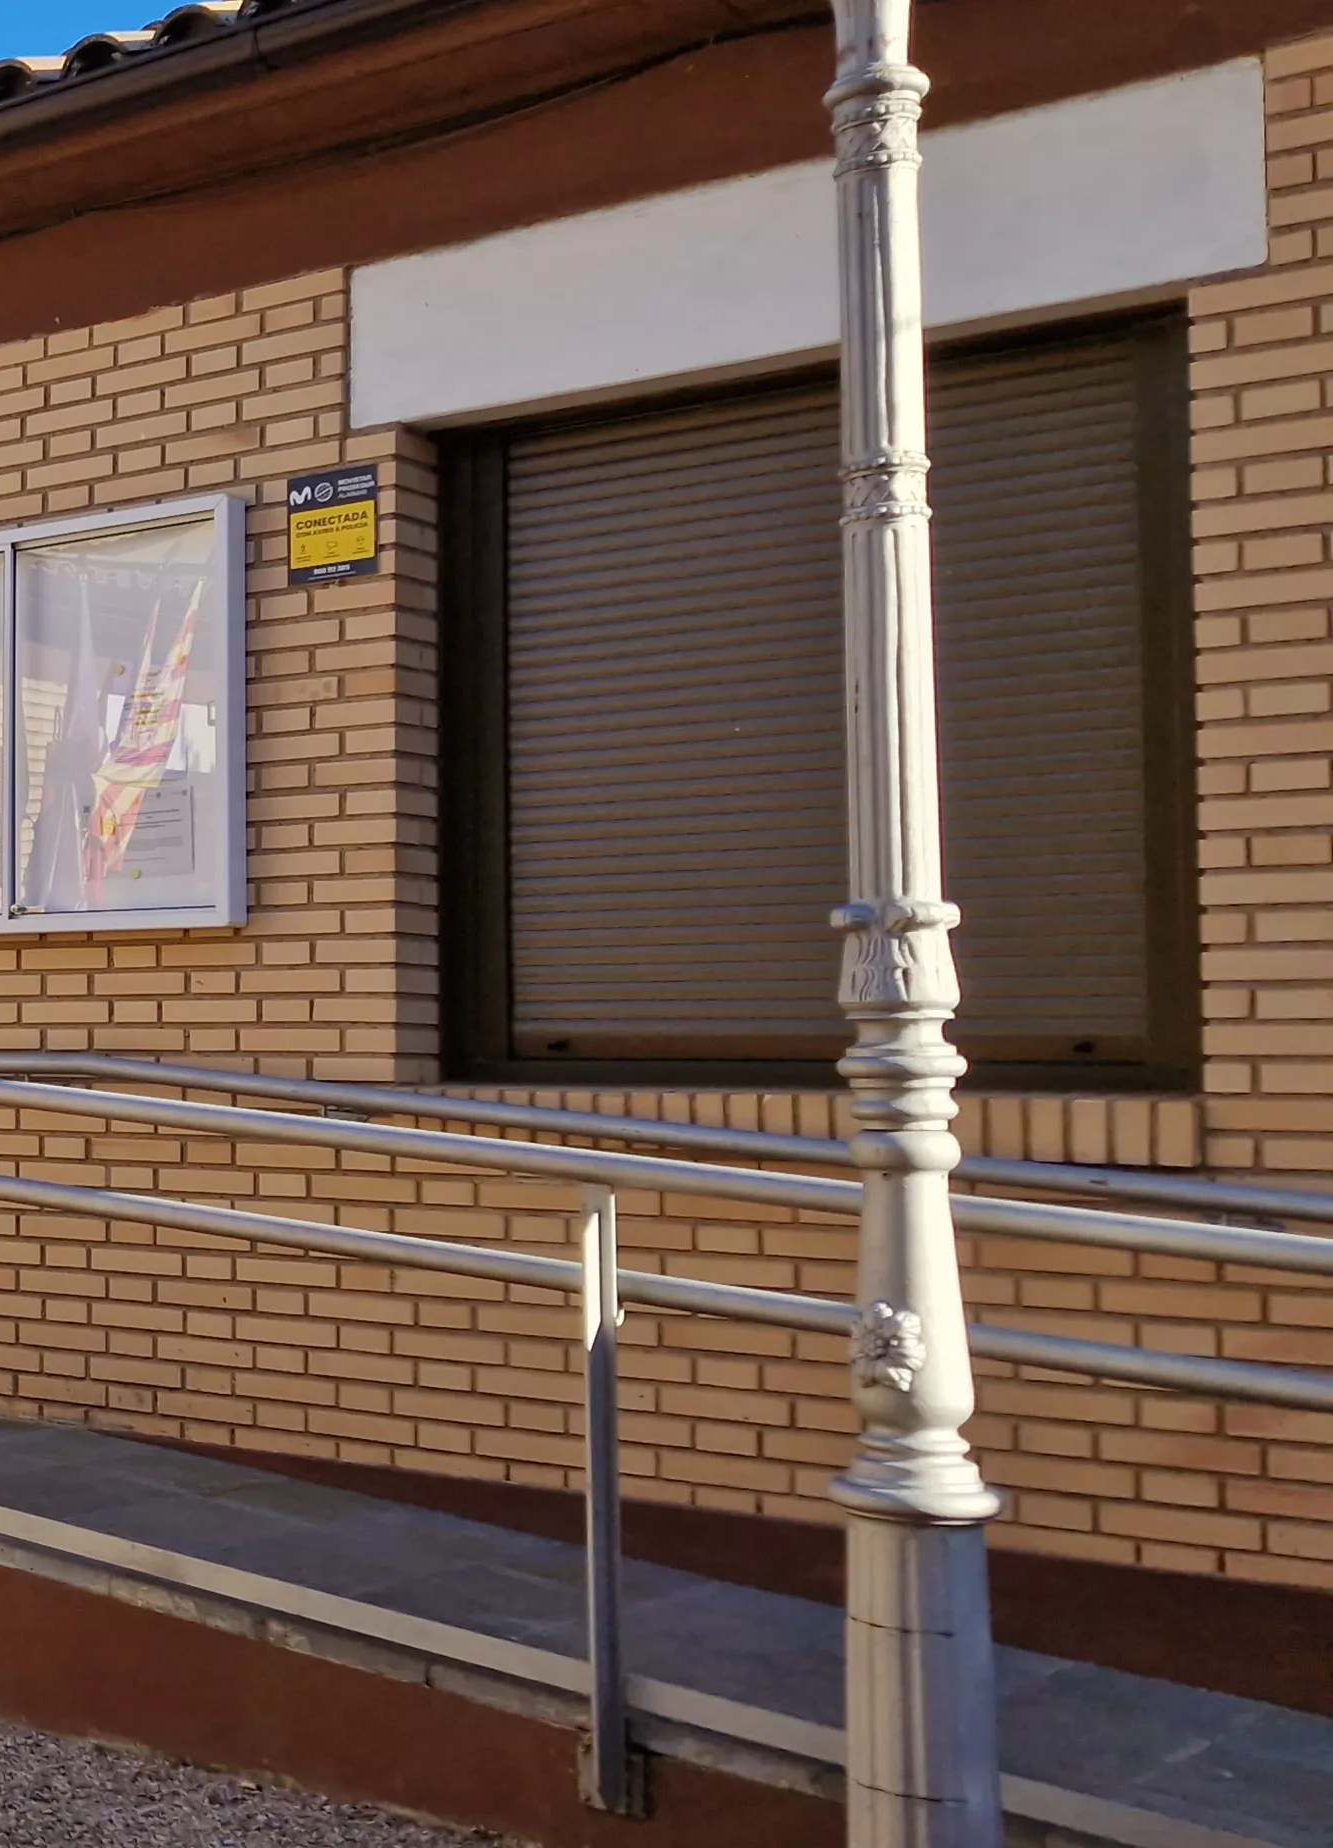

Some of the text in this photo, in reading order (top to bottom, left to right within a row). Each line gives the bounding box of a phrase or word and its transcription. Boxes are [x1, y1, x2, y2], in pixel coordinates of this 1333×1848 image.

[296, 511, 368, 530] CONECTADA
[296, 531, 312, 539] CON
[313, 527, 335, 536] AVISO
